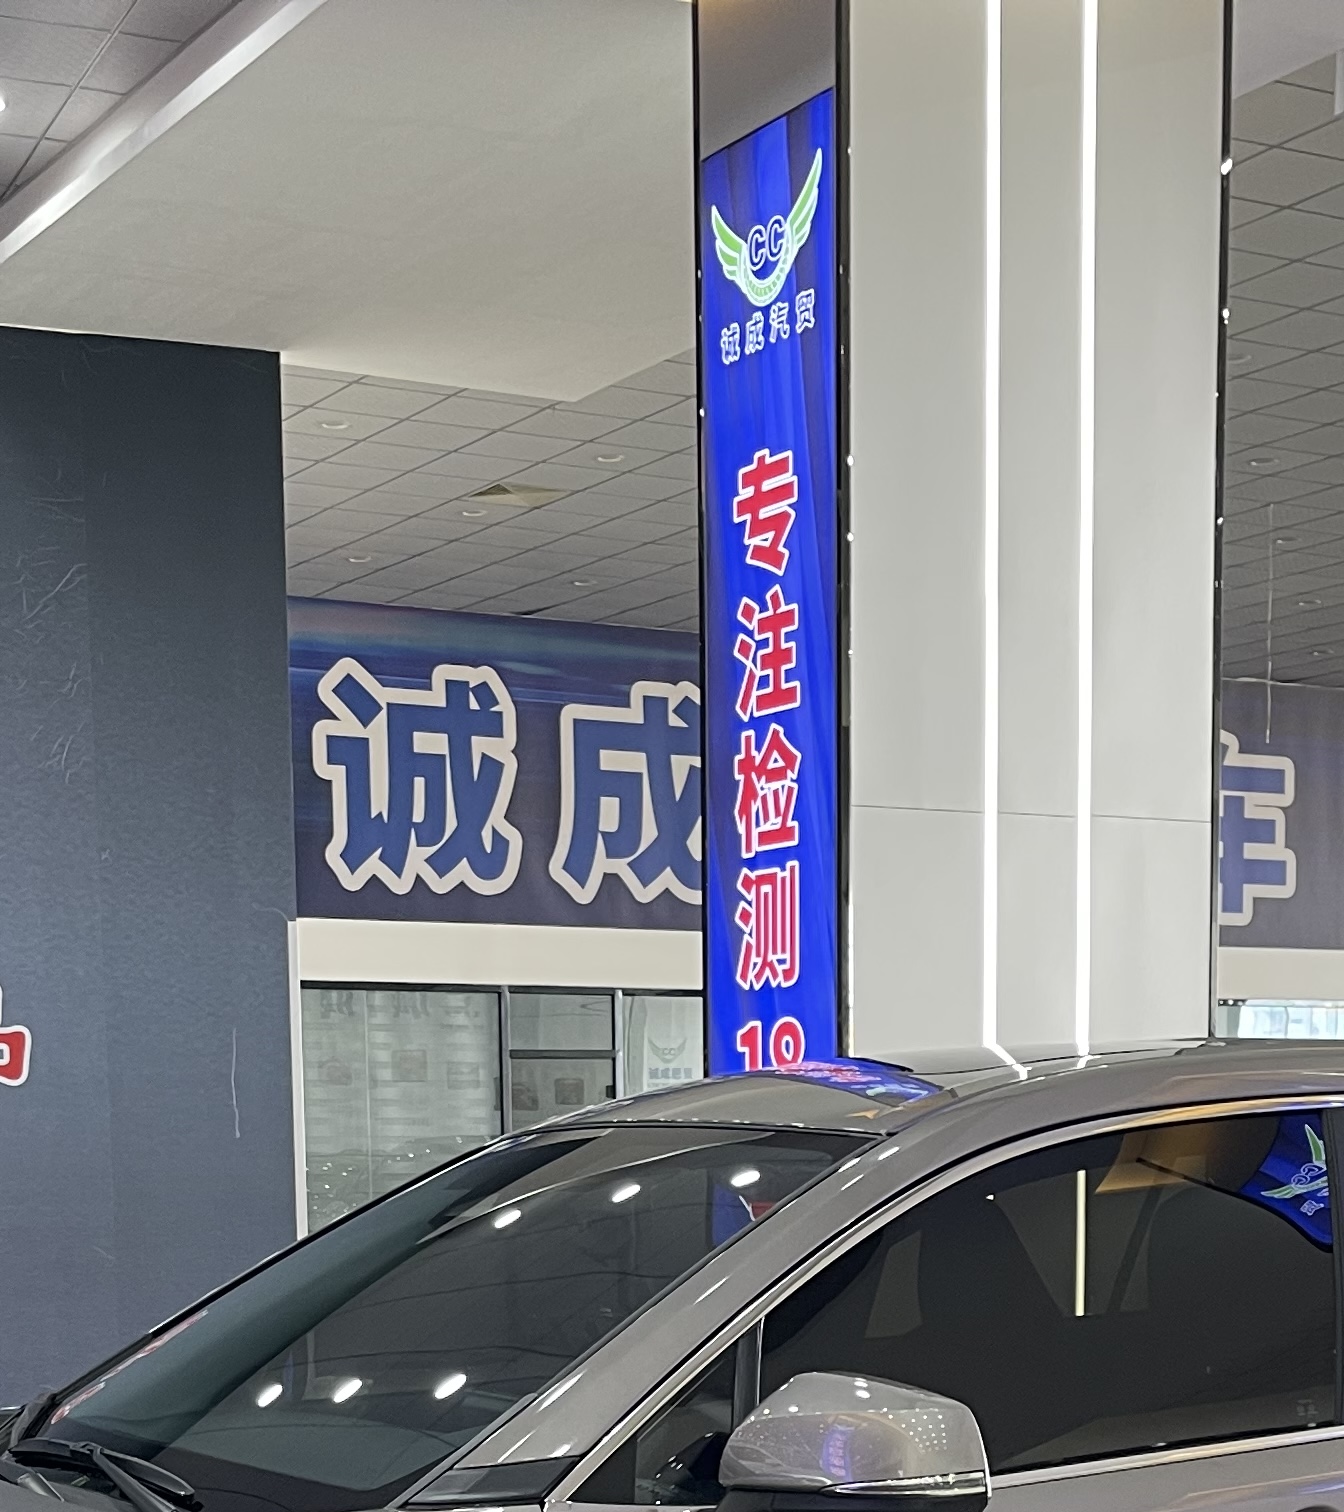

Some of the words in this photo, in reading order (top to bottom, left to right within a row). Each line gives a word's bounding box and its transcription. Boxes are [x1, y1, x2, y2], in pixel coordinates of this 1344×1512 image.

[747, 215, 787, 271] CC
[720, 288, 816, 365] 诚成汽贸
[732, 447, 802, 991] 专注检测
